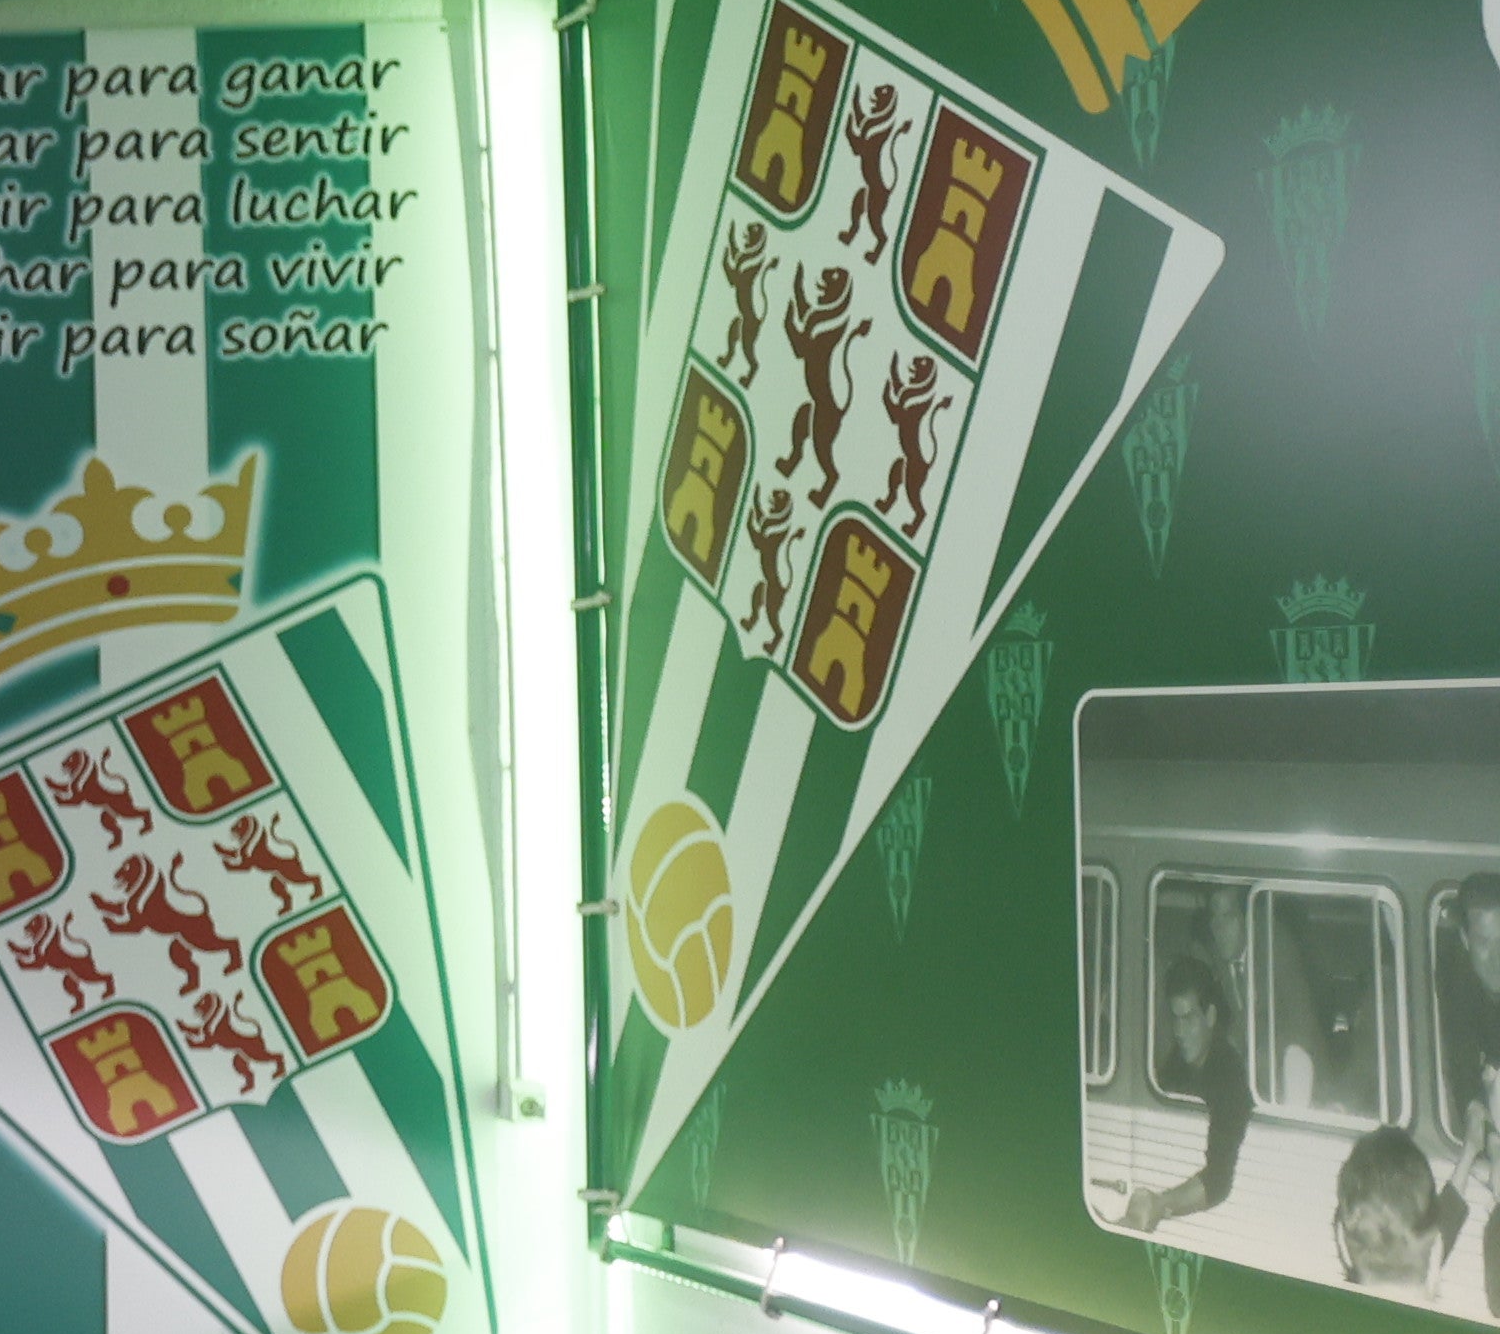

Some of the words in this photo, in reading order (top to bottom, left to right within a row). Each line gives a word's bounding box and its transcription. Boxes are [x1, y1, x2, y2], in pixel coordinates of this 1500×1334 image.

[65, 64, 198, 113] para
[222, 56, 400, 109] ganar
[76, 126, 209, 178] para
[235, 111, 409, 158] sentir
[69, 190, 204, 243] para
[232, 177, 418, 223] luchar
[111, 255, 244, 308] para
[272, 242, 404, 289] vivir
[62, 322, 196, 374] para
[223, 309, 389, 356] soñar
